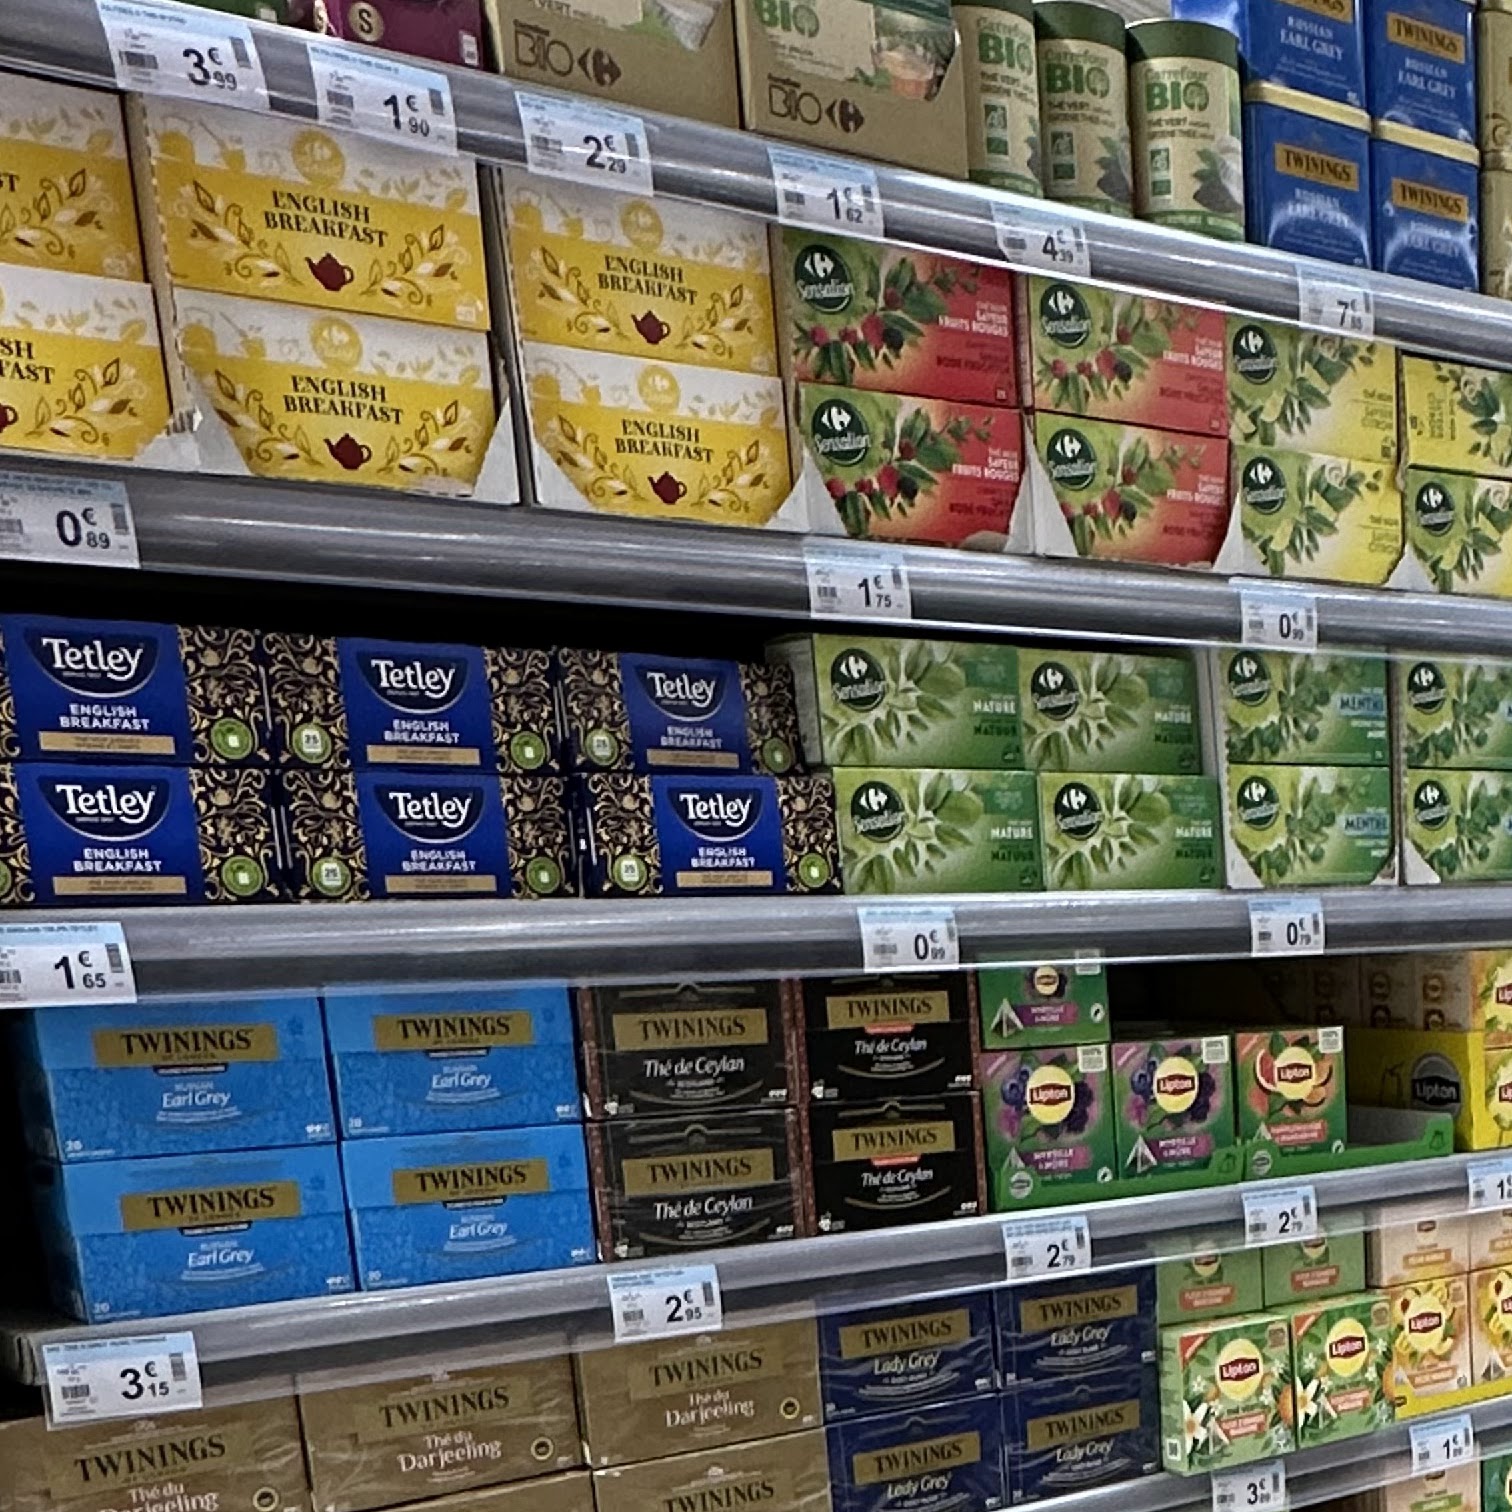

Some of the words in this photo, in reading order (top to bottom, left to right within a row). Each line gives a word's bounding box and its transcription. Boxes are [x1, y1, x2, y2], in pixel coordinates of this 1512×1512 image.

[357, 9, 374, 32] S
[1280, 29, 1308, 50] EARL
[1310, 36, 1345, 61] GREY
[1393, 18, 1460, 54] TWININGS
[514, 31, 574, 77] BIO
[1045, 64, 1110, 98] BIO
[272, 190, 370, 224] ENGLISH
[264, 211, 388, 248] BREAKFAST
[604, 255, 684, 283] ENGLISH
[598, 273, 697, 305] BREAKFAST
[292, 375, 387, 402] ENGLISH
[283, 395, 403, 425] BREAKFAST
[621, 419, 700, 442] ENGLISH
[615, 438, 714, 464] BREAKFAST
[42, 638, 144, 680] Tetley
[371, 659, 456, 698] Tetley
[648, 672, 716, 707] Tetley
[973, 700, 1016, 714] NATURE
[384, 731, 460, 744] BREAKFAST
[392, 719, 449, 732] ENGLISH
[57, 784, 156, 823] Tetley
[389, 792, 472, 829] Tetley
[680, 793, 751, 827] Tetley
[991, 826, 1034, 840] NATURE
[1175, 826, 1212, 838] NATURE
[73, 858, 161, 872] BREAKFAST
[83, 848, 150, 860] ENGLISH
[690, 856, 755, 868] BREAKFAST
[698, 847, 746, 857] ENGLISH
[398, 1013, 510, 1040] TWININGS
[639, 1016, 746, 1041] TWININGS
[122, 1028, 254, 1055] TWININGS
[644, 1059, 672, 1078] Thé
[674, 1059, 692, 1075] de
[694, 1055, 745, 1077] Ceylan
[1280, 1066, 1312, 1081] Lipton
[432, 1073, 460, 1089] Earl
[461, 1070, 491, 1090] Grey
[162, 1091, 193, 1108] Earl
[194, 1089, 230, 1109] Grey
[1030, 1088, 1071, 1102] Lipton
[852, 1127, 937, 1151] TWININGS
[862, 1171, 881, 1187] Thé
[882, 1170, 896, 1184] de
[896, 1167, 933, 1184] Ceylan
[1040, 1295, 1123, 1322] TWININGS
[862, 1318, 952, 1340] TWININGS
[649, 1350, 764, 1388] TWININGS
[874, 1353, 907, 1375] Lady
[908, 1349, 940, 1369] Grey
[1221, 1359, 1259, 1381] Lipton
[379, 1386, 510, 1429] TWININGS
[425, 1433, 450, 1450] Thé
[452, 1430, 473, 1445] du
[1056, 1445, 1087, 1462] Lady
[1088, 1440, 1114, 1456] Grey
[74, 1434, 226, 1482] TWININGS
[397, 1438, 501, 1473] Darjeeling
[129, 1485, 161, 1503] Thé
[163, 1482, 184, 1496] du
